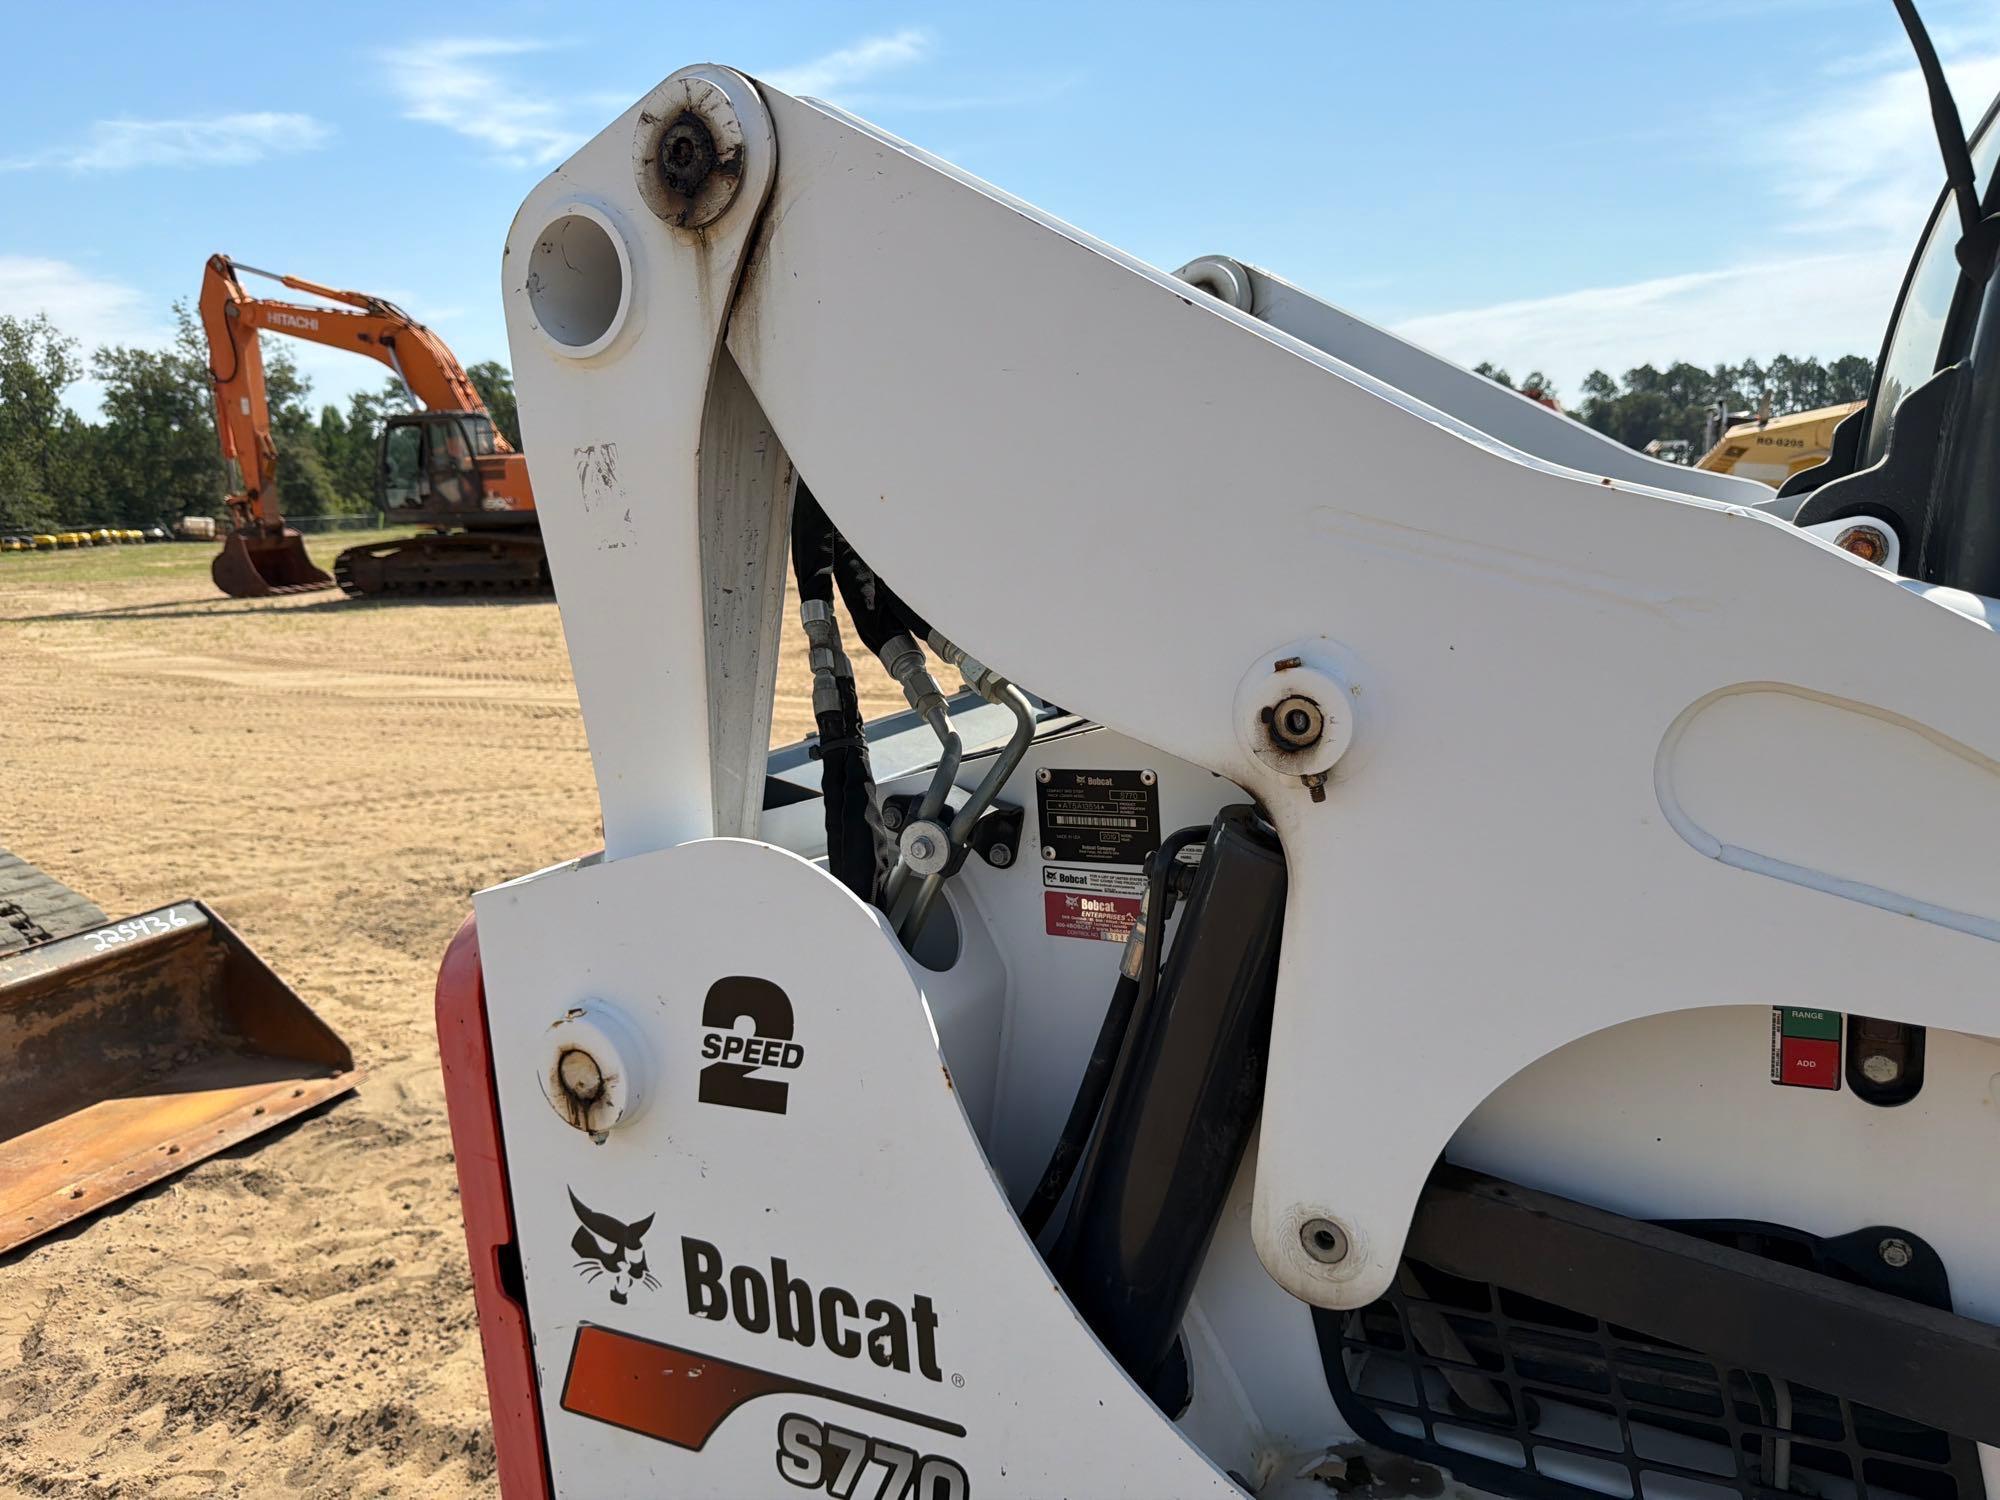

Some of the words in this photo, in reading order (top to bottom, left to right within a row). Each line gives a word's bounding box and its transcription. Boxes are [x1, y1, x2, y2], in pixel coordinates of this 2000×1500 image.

[267, 312, 319, 331] HITACHI
[1087, 777, 1113, 786] Bobcat
[1059, 873, 1088, 885] Bobcat
[1081, 898, 1115, 912] Bobcat
[1081, 911, 1126, 921] ENTERPRISES
[84, 908, 188, 951] 225436
[1791, 1010, 1824, 1020] RANGE
[701, 1033, 805, 1069] SPEED
[1796, 1059, 1817, 1068] ADD
[680, 1235, 943, 1383] Bobcat
[775, 1411, 970, 1500] S770
